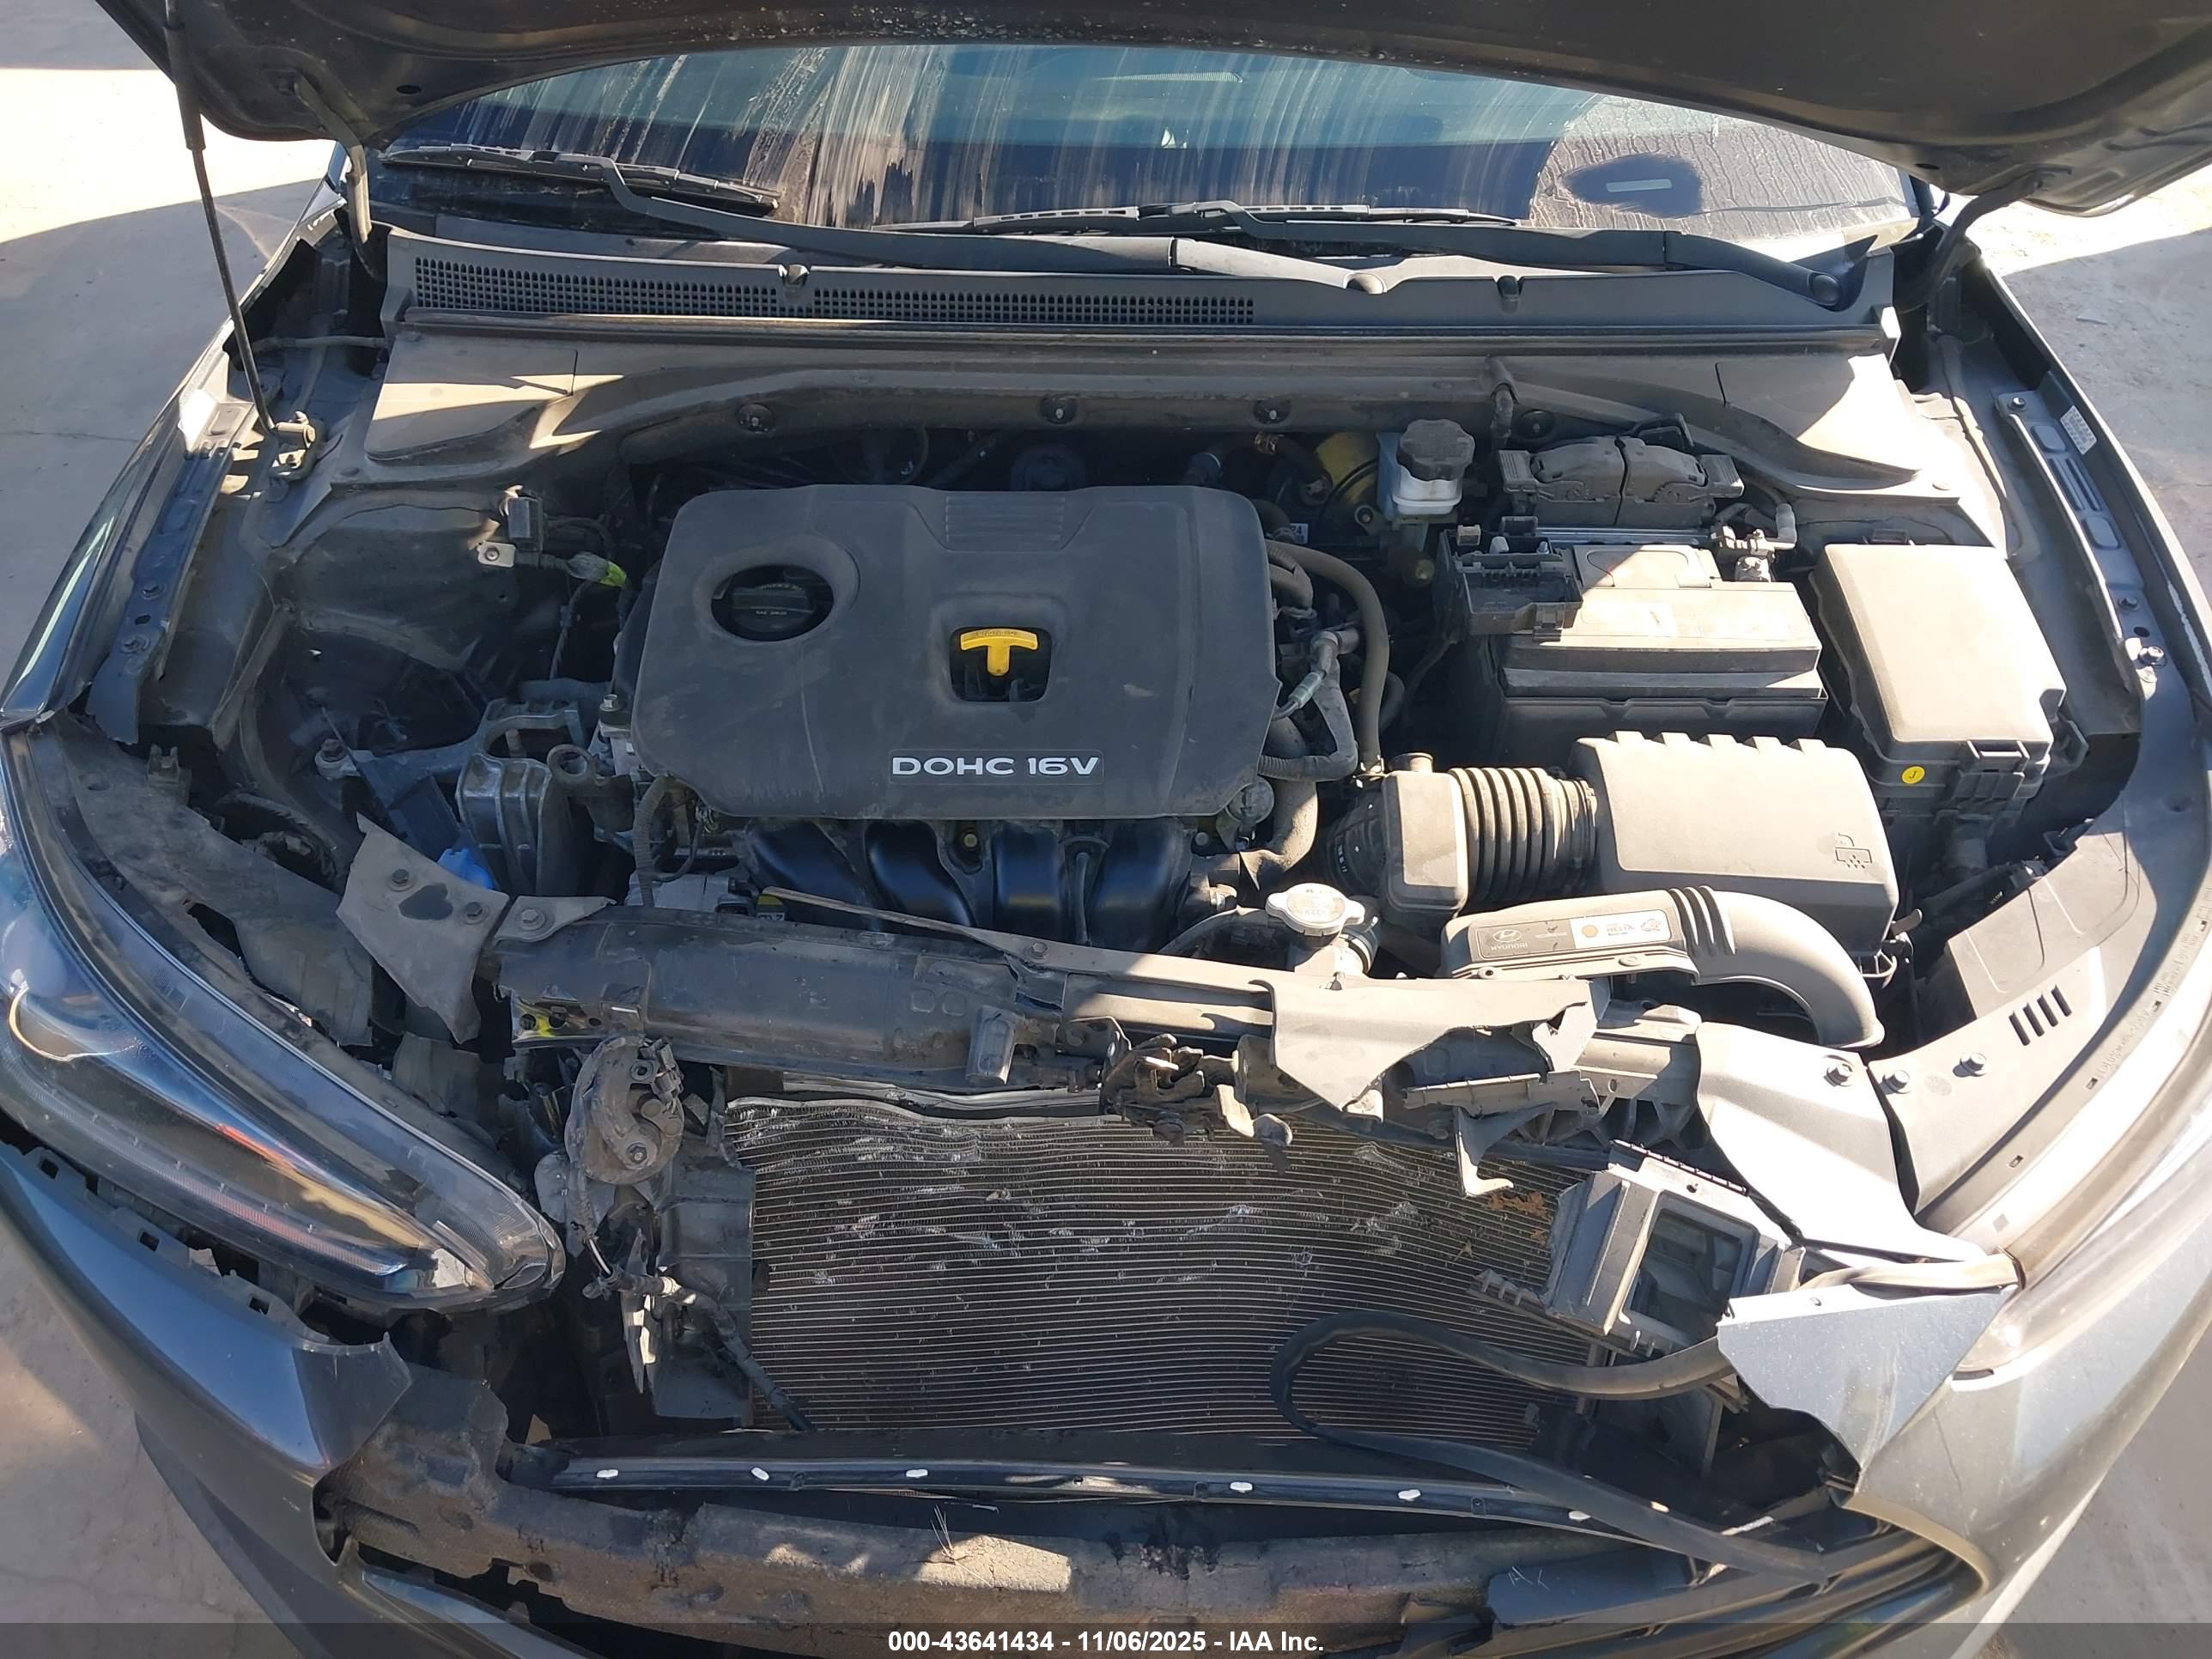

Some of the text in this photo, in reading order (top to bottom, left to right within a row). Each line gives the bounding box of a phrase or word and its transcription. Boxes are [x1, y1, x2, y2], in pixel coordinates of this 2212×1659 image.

[892, 757, 1099, 775] DOHC 16V
[1491, 941, 1528, 951] HYUNDAI
